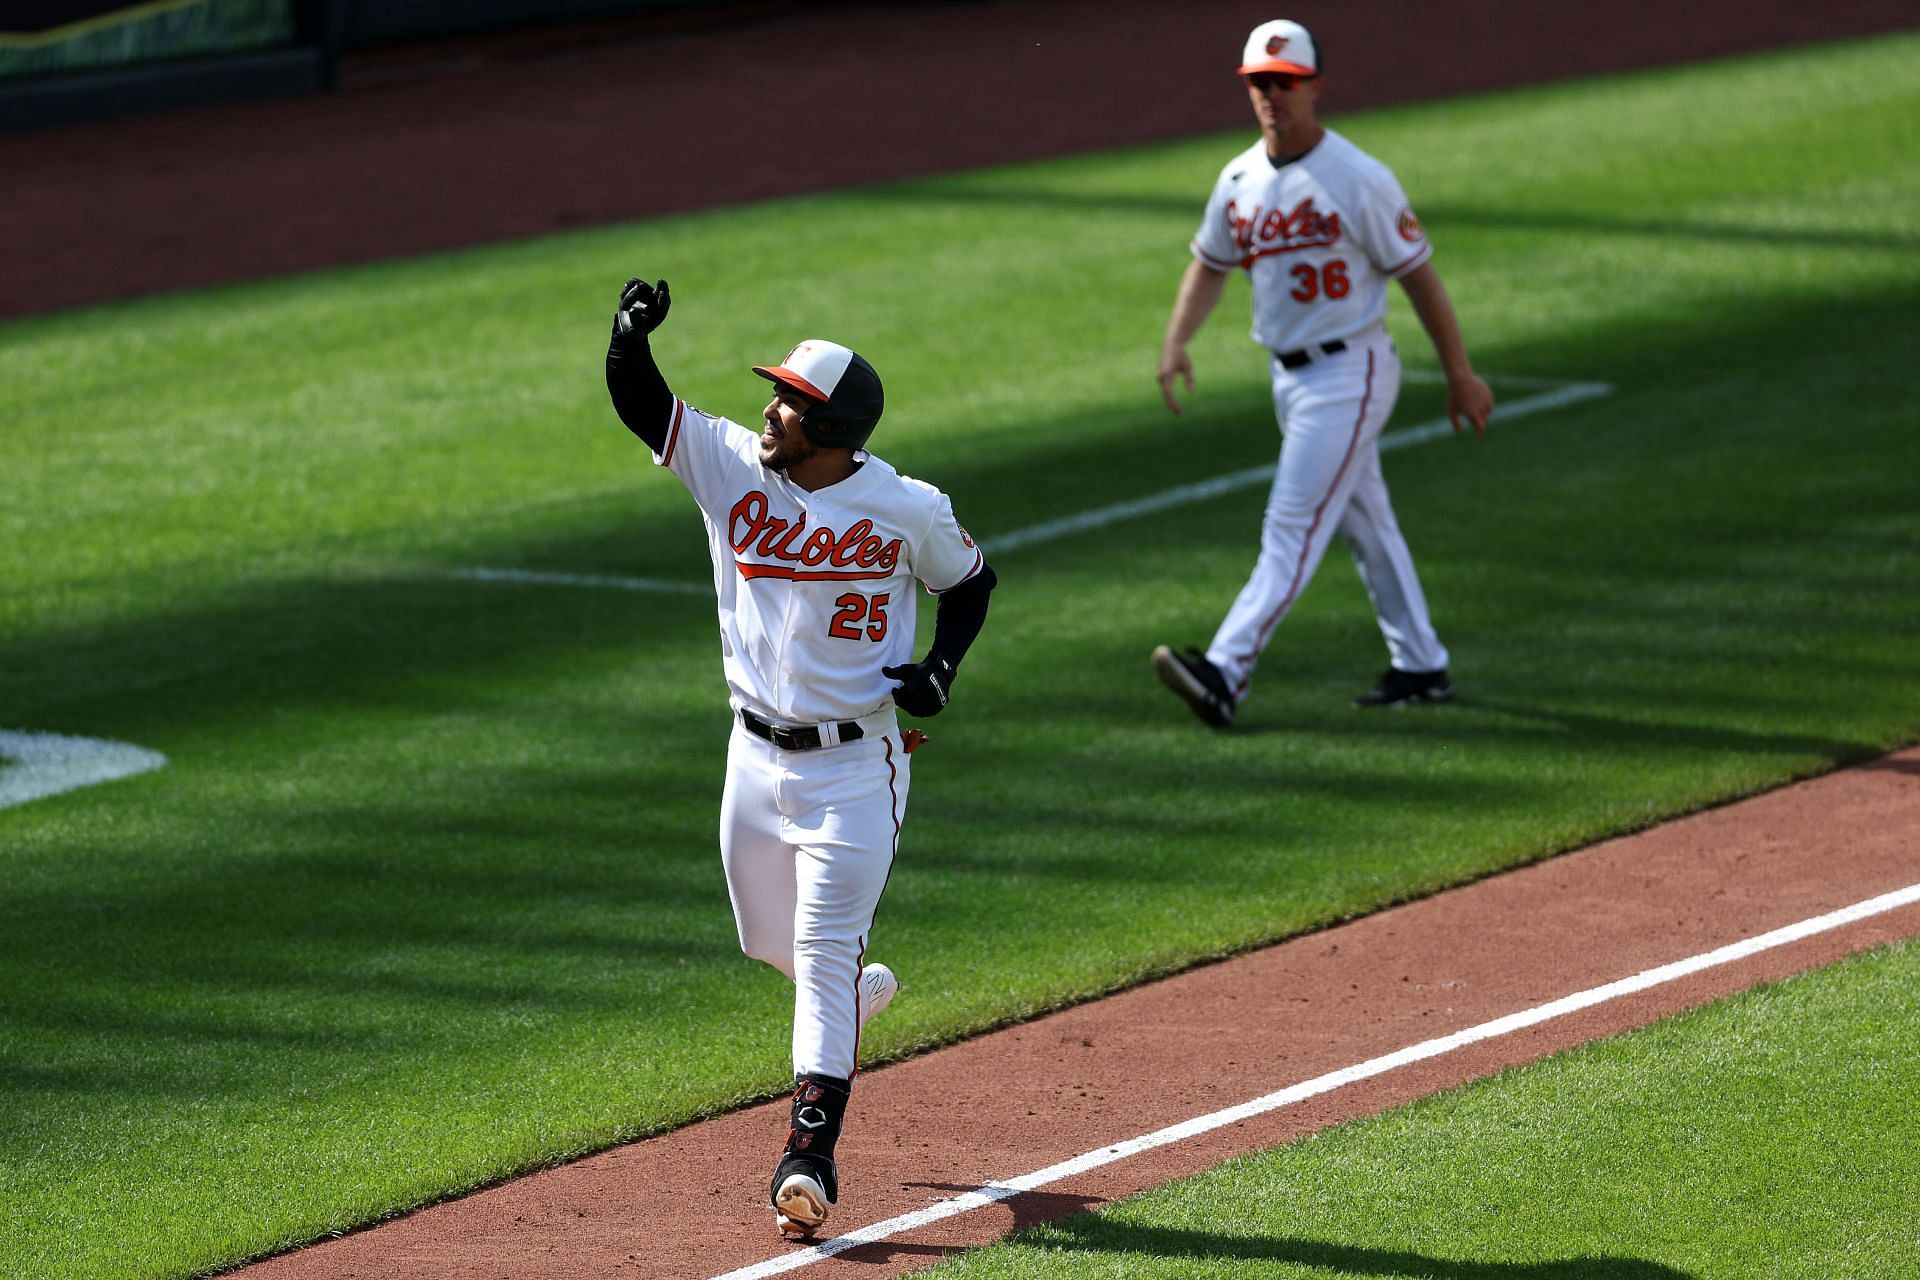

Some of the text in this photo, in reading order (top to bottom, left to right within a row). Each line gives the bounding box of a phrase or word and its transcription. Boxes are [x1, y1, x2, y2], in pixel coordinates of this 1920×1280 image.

[1291, 260, 1350, 303] 36
[729, 491, 903, 567] Orioles
[828, 593, 890, 642] 25
